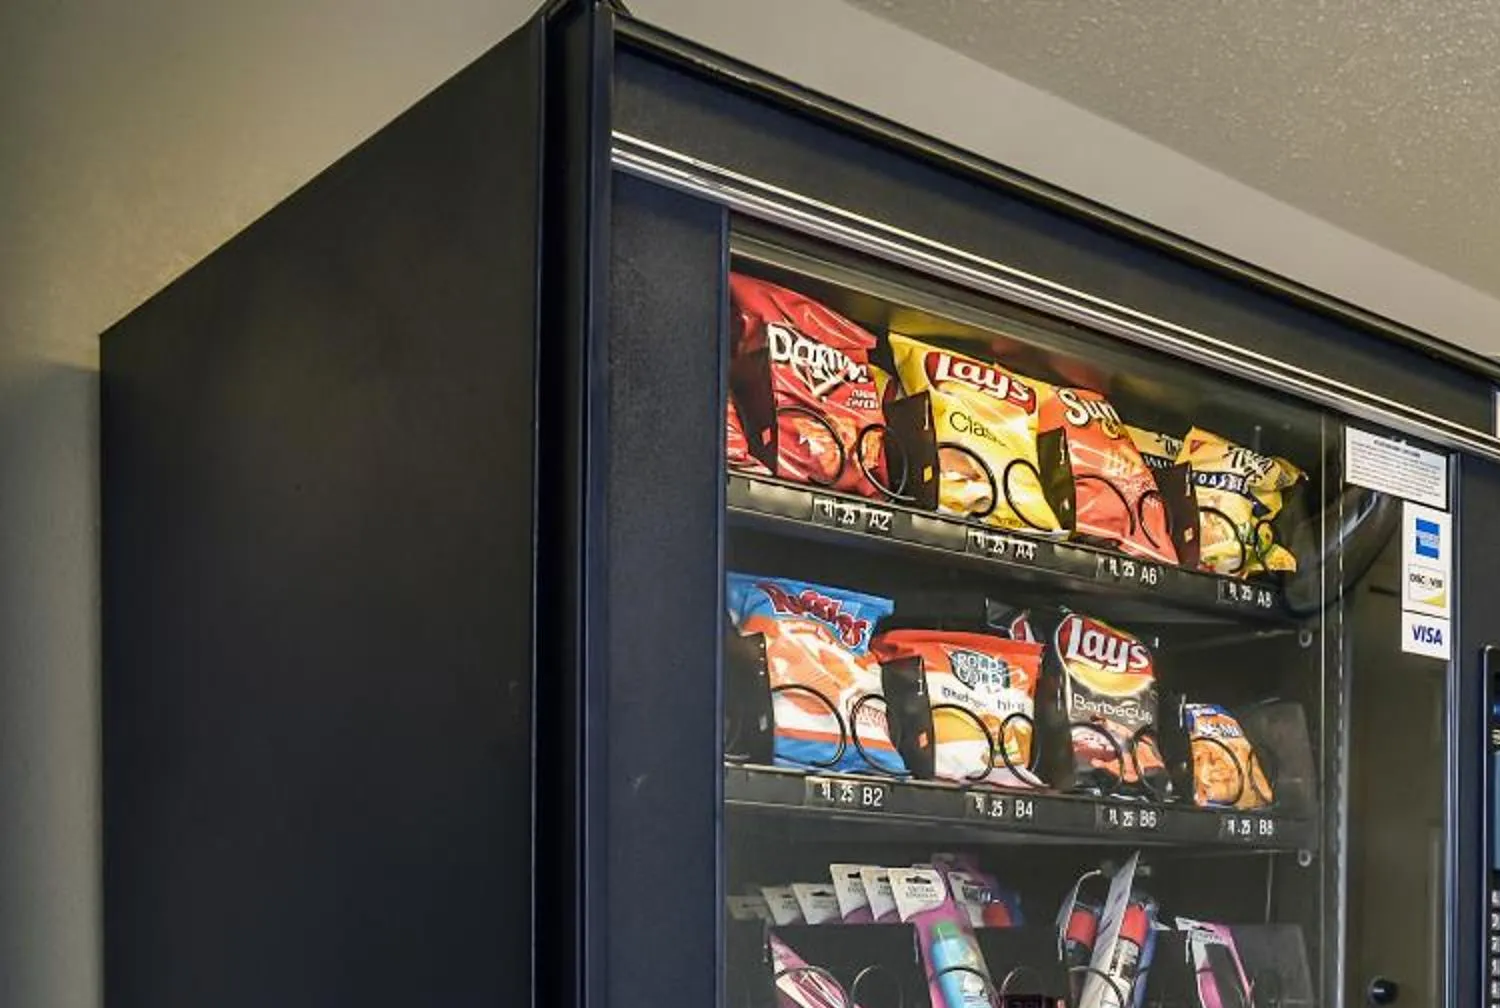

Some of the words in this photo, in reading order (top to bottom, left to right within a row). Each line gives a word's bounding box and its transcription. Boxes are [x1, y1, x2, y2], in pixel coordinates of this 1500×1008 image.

[869, 510, 889, 530] A2
[1015, 544, 1034, 560] A4
[1140, 567, 1157, 584] A6
[1412, 624, 1443, 647] VISA
[1074, 693, 1152, 724] Barbecue
[863, 787, 883, 806] B2
[1015, 800, 1033, 818] B4
[1140, 810, 1157, 827] B6
